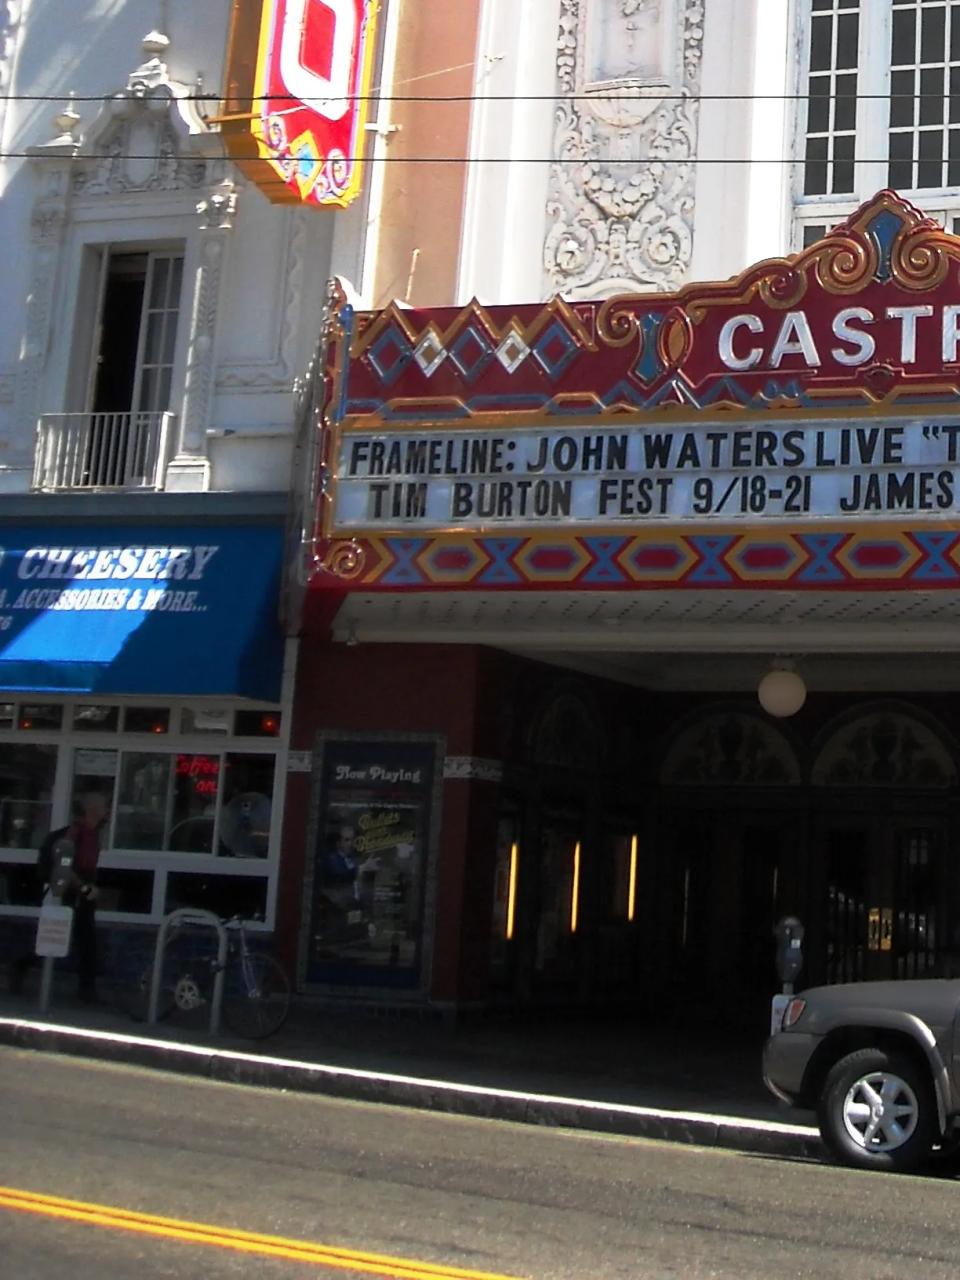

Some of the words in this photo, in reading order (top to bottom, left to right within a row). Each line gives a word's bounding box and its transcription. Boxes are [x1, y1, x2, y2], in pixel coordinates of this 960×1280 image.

[349, 437, 516, 477] FRAMELINE:
[526, 434, 629, 473] JOHN
[643, 430, 804, 471] WATERS
[816, 427, 903, 466] LIVE
[373, 481, 427, 519] TIM
[452, 478, 572, 518] BURTON
[598, 477, 673, 516] FEST
[693, 474, 810, 514] 9/18-21
[839, 470, 954, 511] JAMES
[17, 545, 219, 580] CHEESERY
[12, 587, 129, 611] ACCESSORIES
[125, 588, 144, 611] &
[336, 765, 367, 781] Now
[369, 766, 422, 784] Playing
